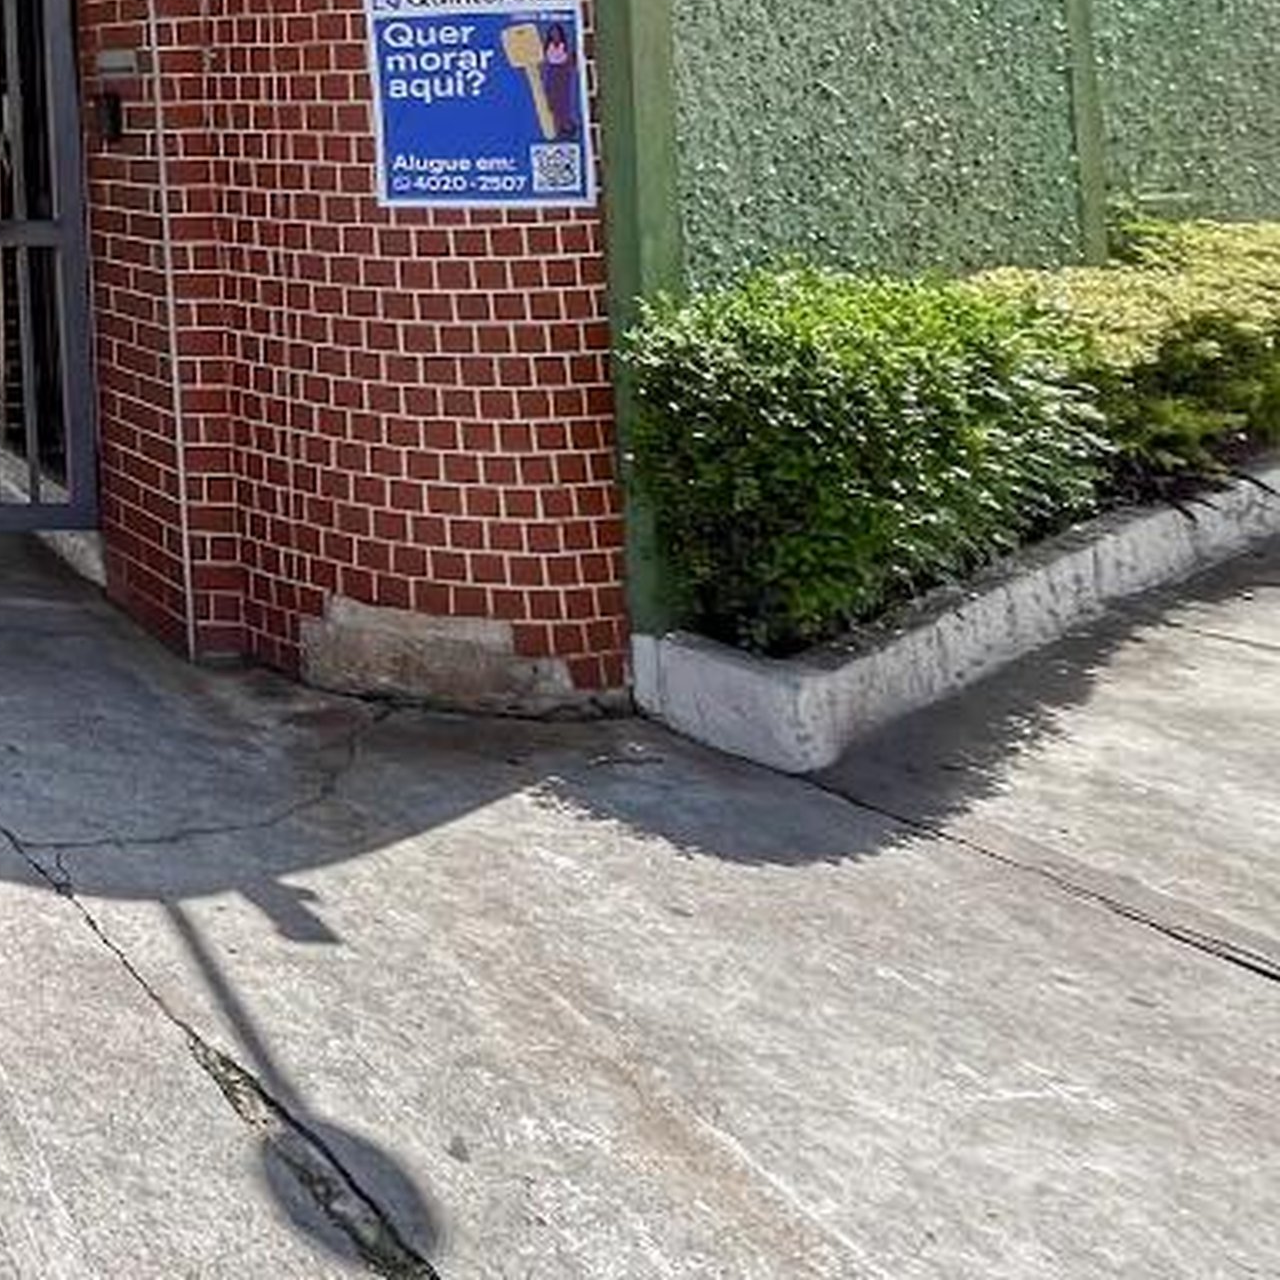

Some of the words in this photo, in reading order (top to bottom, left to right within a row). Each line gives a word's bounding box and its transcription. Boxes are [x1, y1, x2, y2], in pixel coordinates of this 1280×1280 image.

[383, 23, 475, 48] Quer
[386, 48, 494, 71] morar
[388, 71, 486, 104] aqui?
[392, 154, 472, 175] Alugue
[413, 175, 467, 192] 4020
[478, 174, 527, 191] 2507
